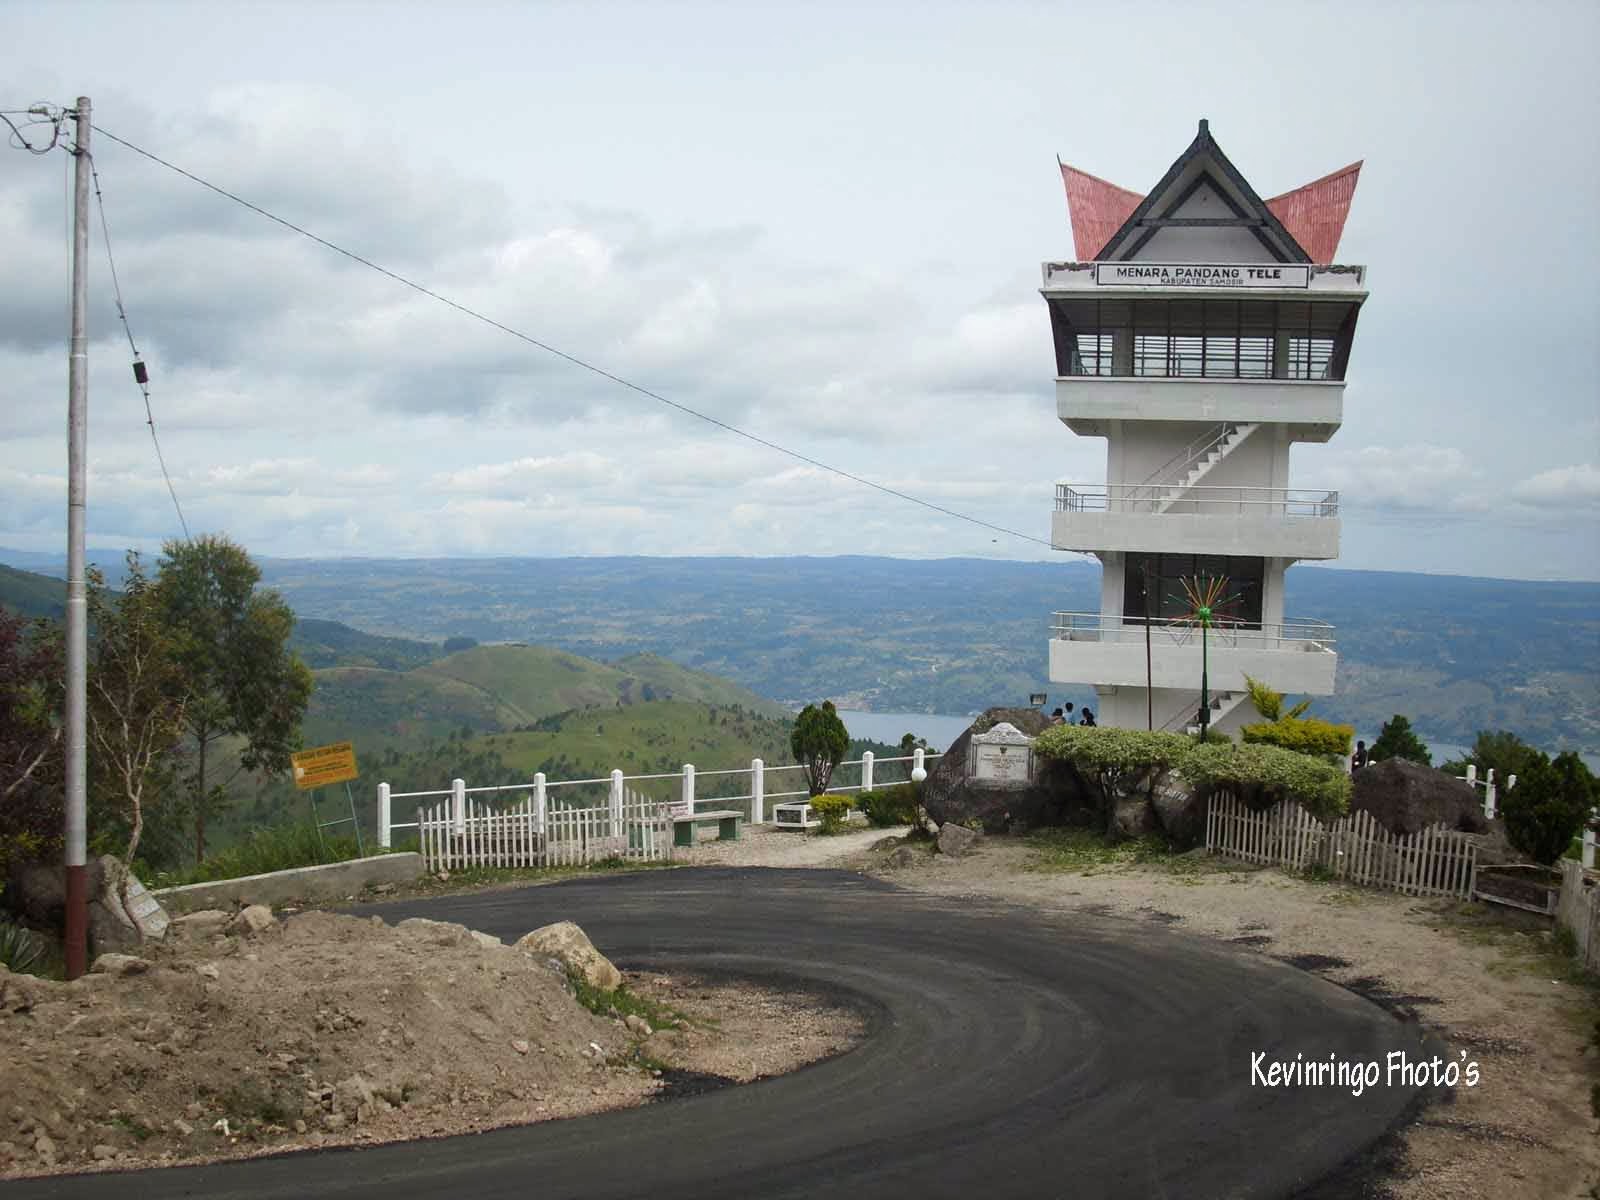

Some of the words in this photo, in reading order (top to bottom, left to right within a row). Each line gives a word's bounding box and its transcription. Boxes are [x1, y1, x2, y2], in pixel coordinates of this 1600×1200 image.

[1116, 267, 1169, 278] MENARA
[1175, 268, 1240, 279] PANDANG
[1247, 269, 1281, 279] TELE
[1160, 277, 1207, 285] KABUPATEN
